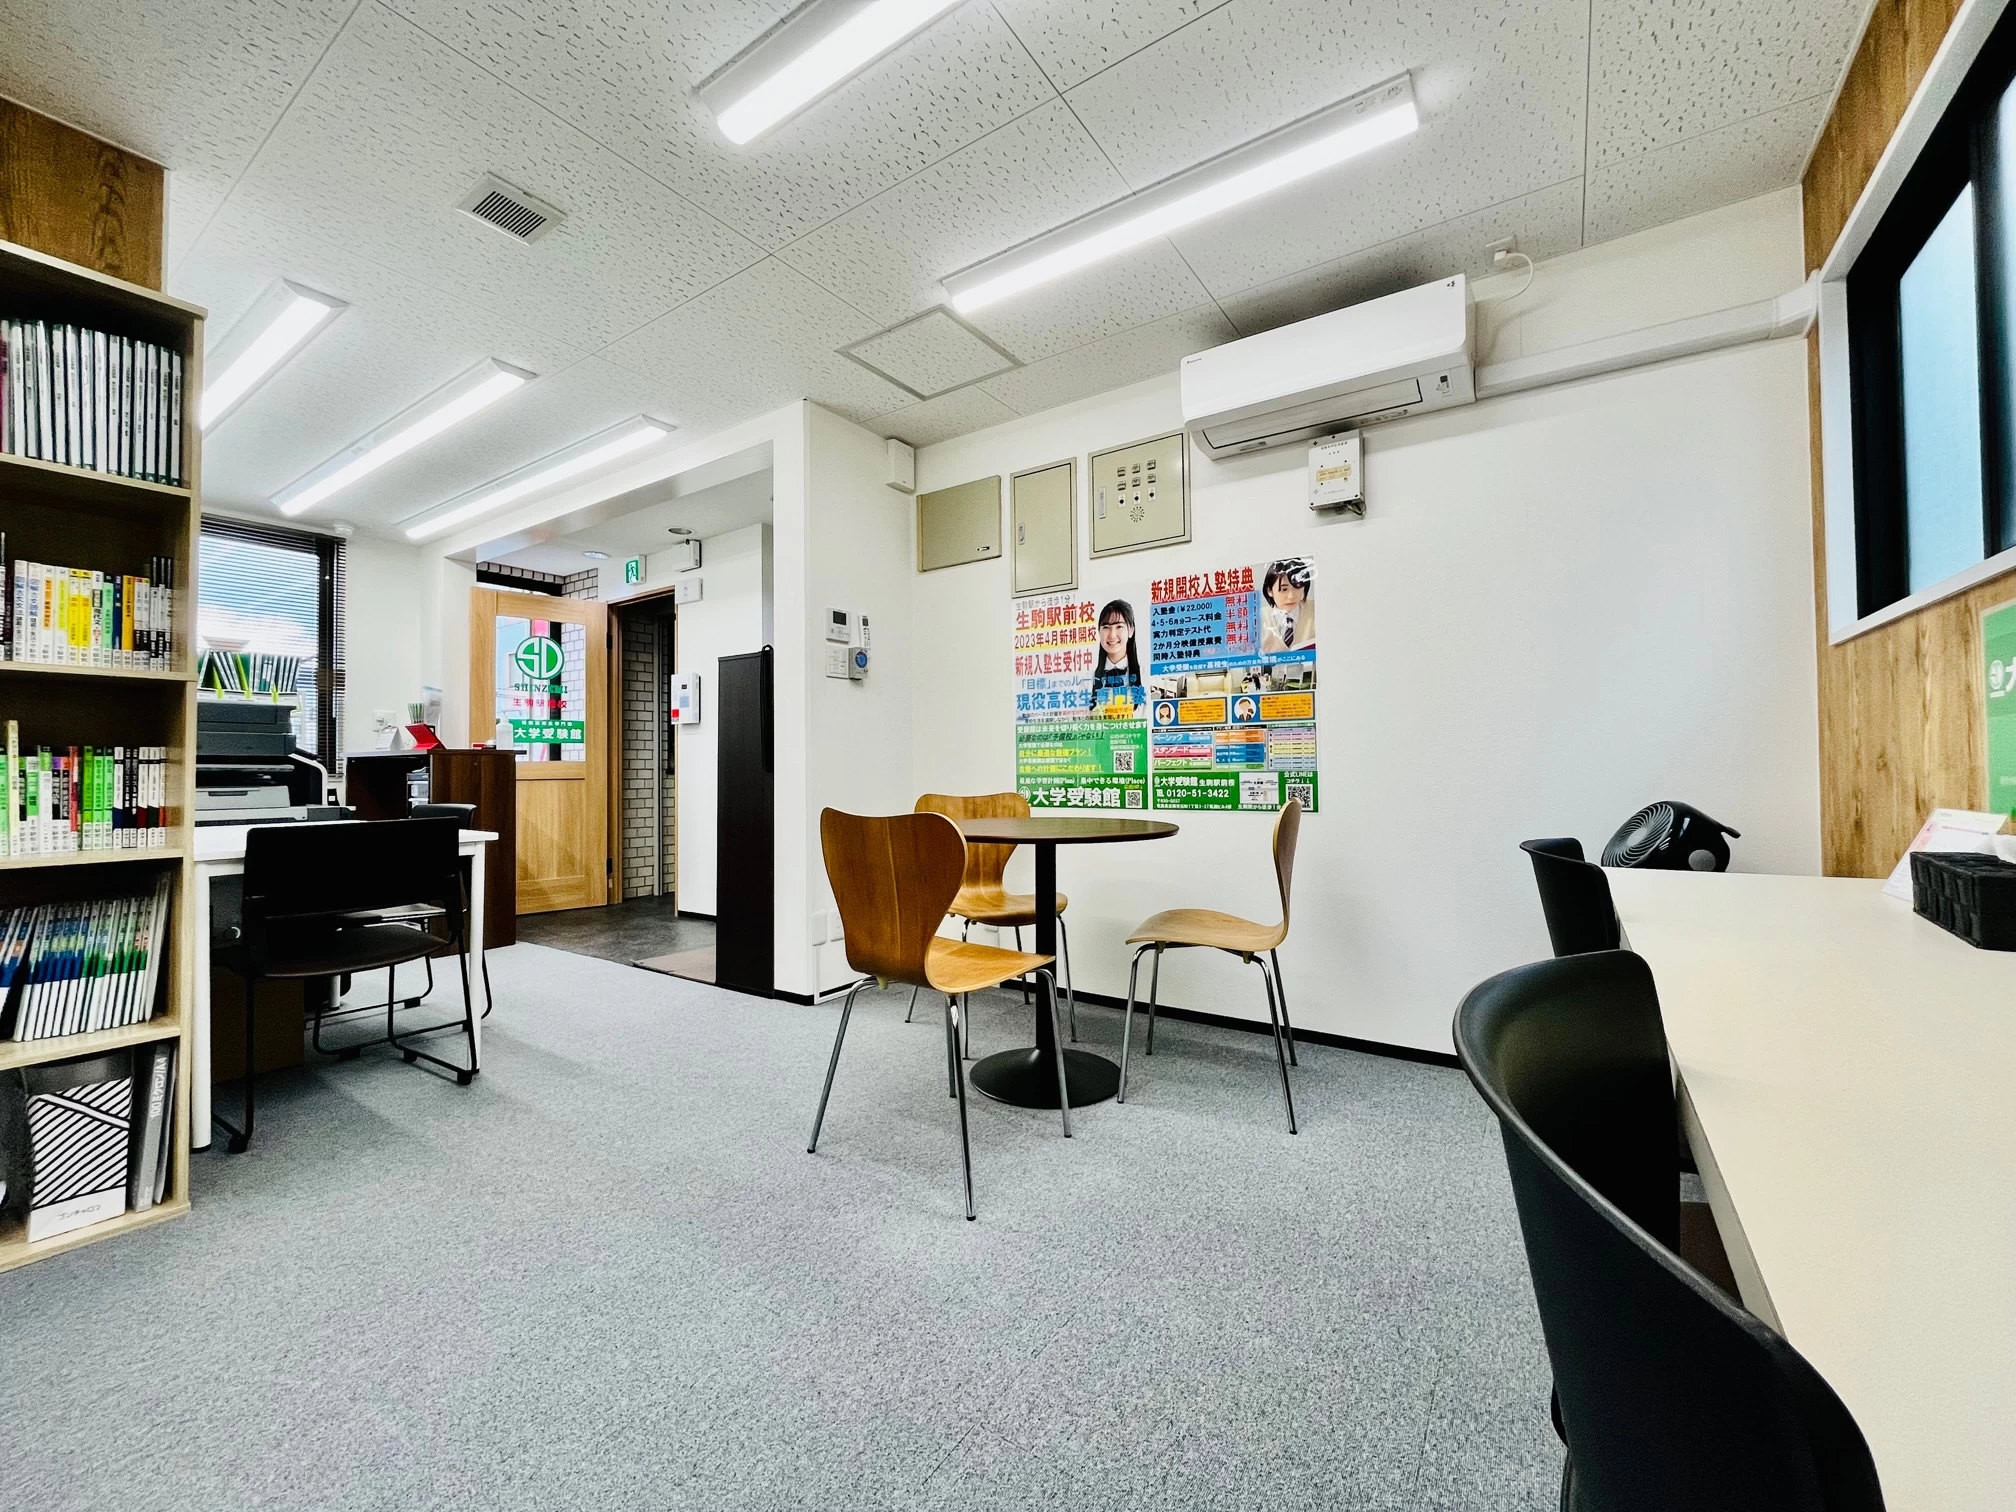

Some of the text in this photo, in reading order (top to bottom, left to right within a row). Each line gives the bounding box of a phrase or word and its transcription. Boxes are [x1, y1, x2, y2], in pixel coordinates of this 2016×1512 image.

[1151, 566, 1254, 602] 新規開校入塾特典
[1015, 600, 1095, 631] 生駒駅前校
[1014, 626, 1097, 649] 2023年4月新規開校
[1152, 625, 1212, 639] 実力判定テスト代
[1153, 636, 1222, 650] 2か月分映像授業費
[1015, 648, 1093, 676] 新規入塾生受付中
[1153, 649, 1201, 661] 同時入塾特典
[1016, 685, 1147, 711] 現役高校生専門塾
[514, 727, 582, 740] 大学受験館
[1153, 734, 1183, 742] ベーシック
[1154, 746, 1190, 754] スタンダード
[1154, 758, 1188, 767] パーフェクト
[1160, 776, 1235, 787] 大学受験館 生駒駅前校
[1033, 786, 1121, 807] 大学受験館
[1166, 789, 1230, 798] 0120-51-3422
